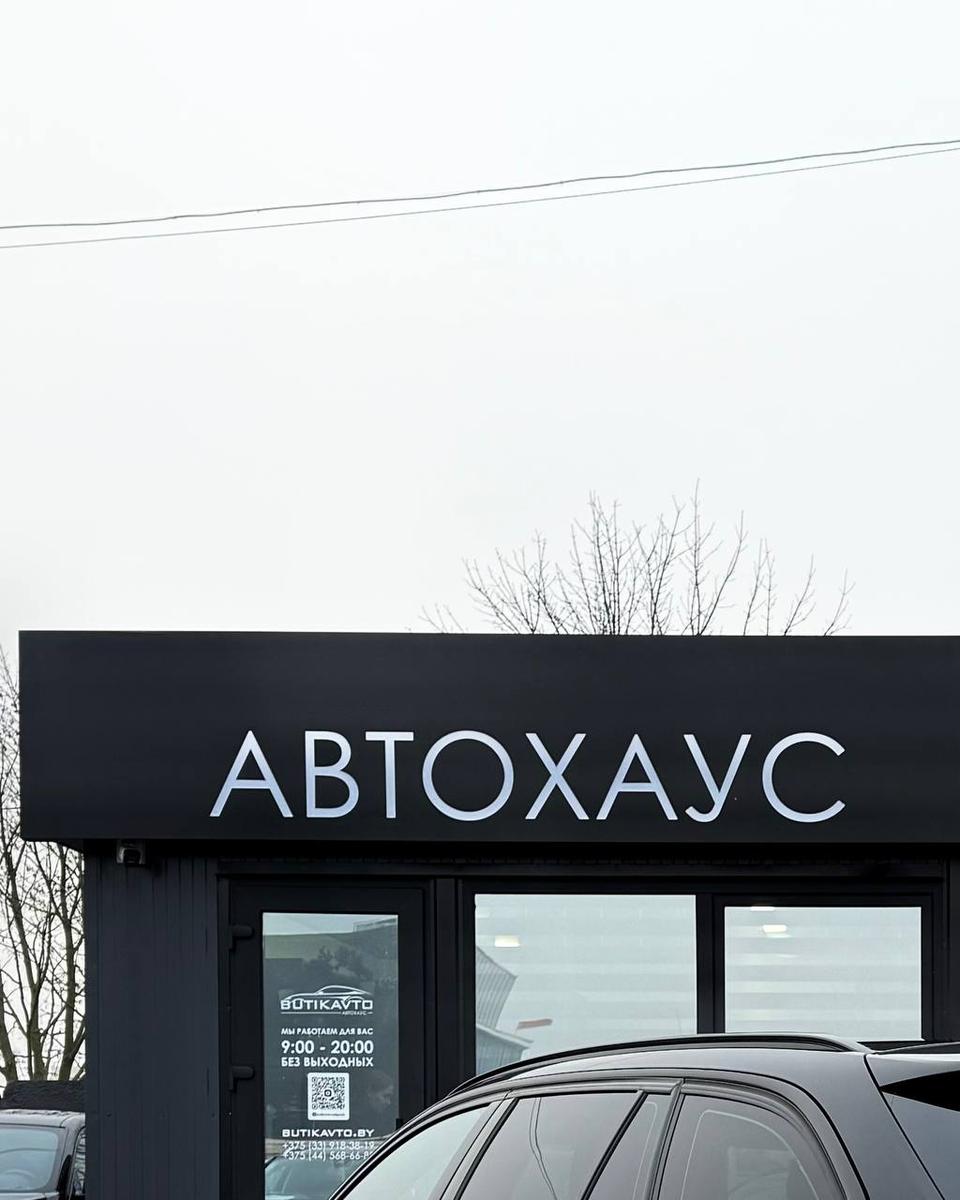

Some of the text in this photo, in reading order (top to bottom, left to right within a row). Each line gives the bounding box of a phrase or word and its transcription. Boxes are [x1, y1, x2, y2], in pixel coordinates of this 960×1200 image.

[209, 730, 846, 823] АВТОХАУС
[280, 999, 374, 1010] BUTIKAVTO
[281, 1040, 315, 1054] 9:00
[330, 1040, 374, 1054] 20:00
[281, 1057, 374, 1068] БЕЗ ВЫХОДНЫХ
[282, 1129, 375, 1137] BUTIKAVTO.BY
[283, 1141, 375, 1152] +375 (33) 918-38-19
[283, 1151, 372, 1162] +375 (44) 568-66-8
